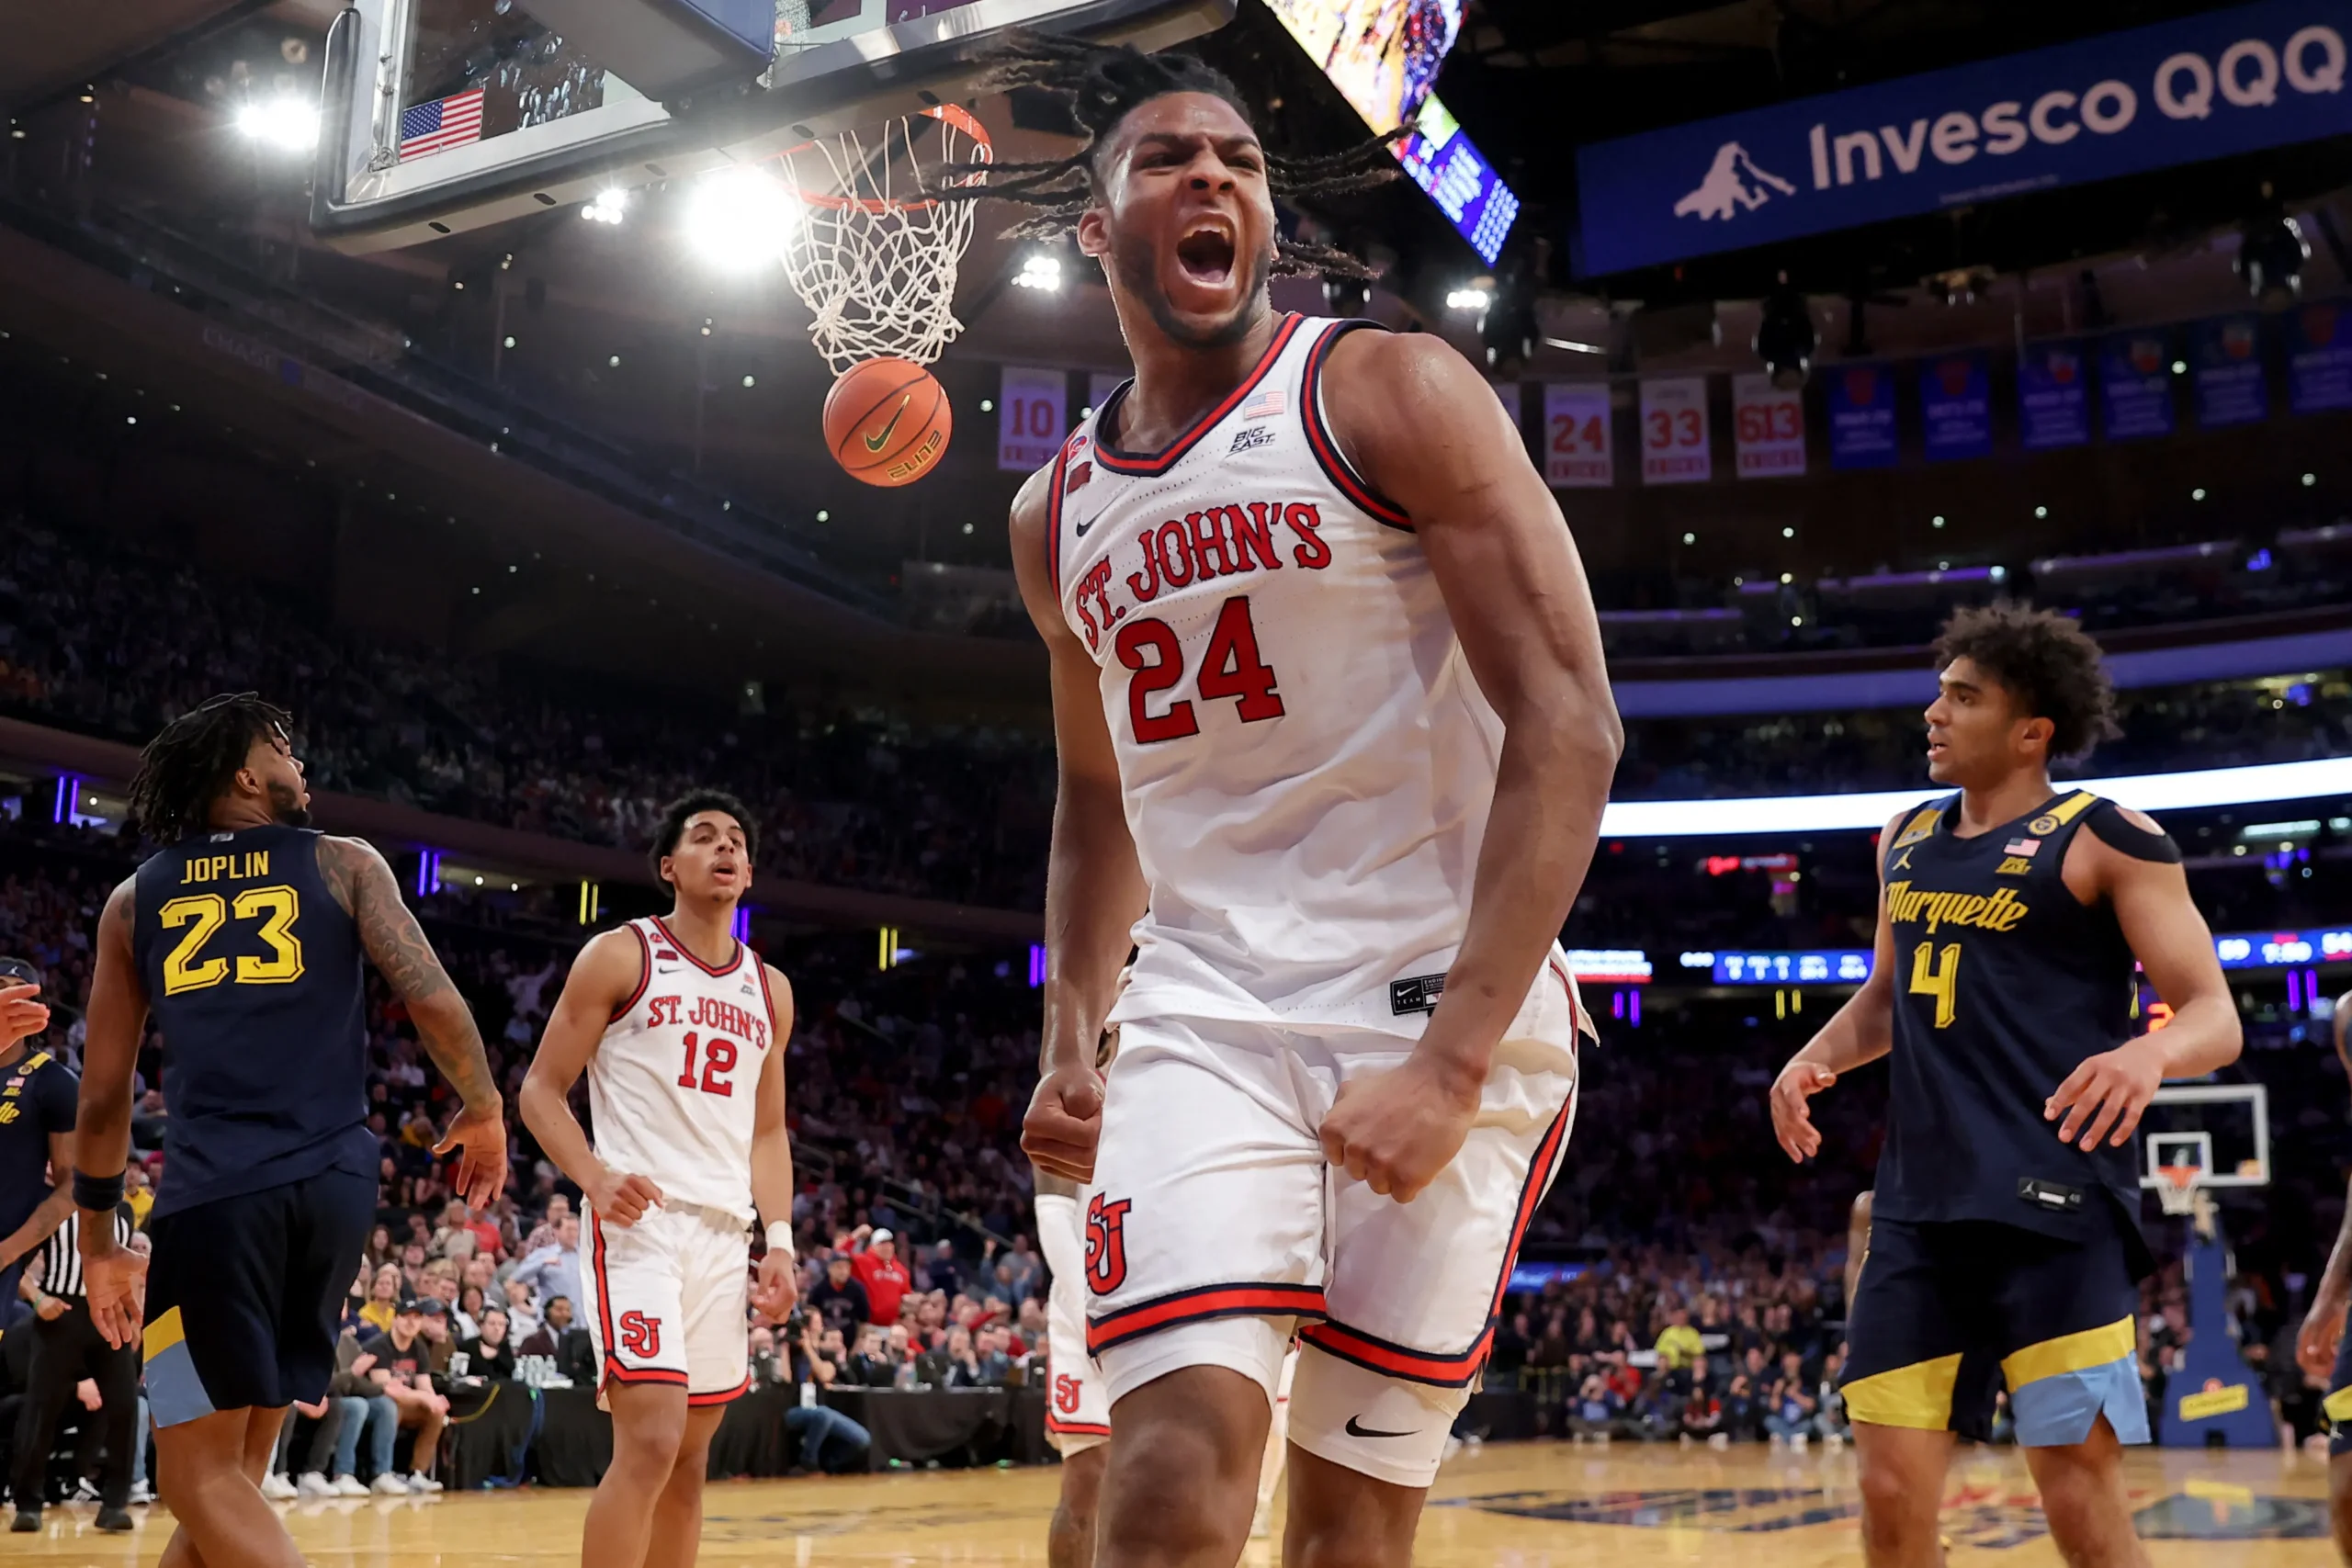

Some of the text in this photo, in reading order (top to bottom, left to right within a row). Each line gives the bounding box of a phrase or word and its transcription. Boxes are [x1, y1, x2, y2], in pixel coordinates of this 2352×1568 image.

[1809, 25, 2347, 190] Invesco QQQ
[1012, 397, 1055, 438] 10
[1234, 425, 1266, 443] BIG
[1552, 414, 1603, 454] 24
[1647, 408, 1702, 448] 33
[1736, 402, 1802, 443] 613
[886, 429, 943, 481] ELITE
[1228, 433, 1276, 453] EAST
[1076, 502, 1331, 653] ST. JOHN'S
[1114, 594, 1285, 744] 24
[180, 850, 269, 885] JOPLIN
[1886, 880, 2030, 934] Marquette
[158, 884, 306, 997] 23
[1396, 997, 1421, 1005] TEAM
[1908, 941, 1962, 1029] 4
[647, 995, 766, 1051] ST. JOHN'S
[678, 1031, 738, 1098] 12
[620, 1310, 662, 1359] SJ
[1056, 1374, 1082, 1414] SJ
